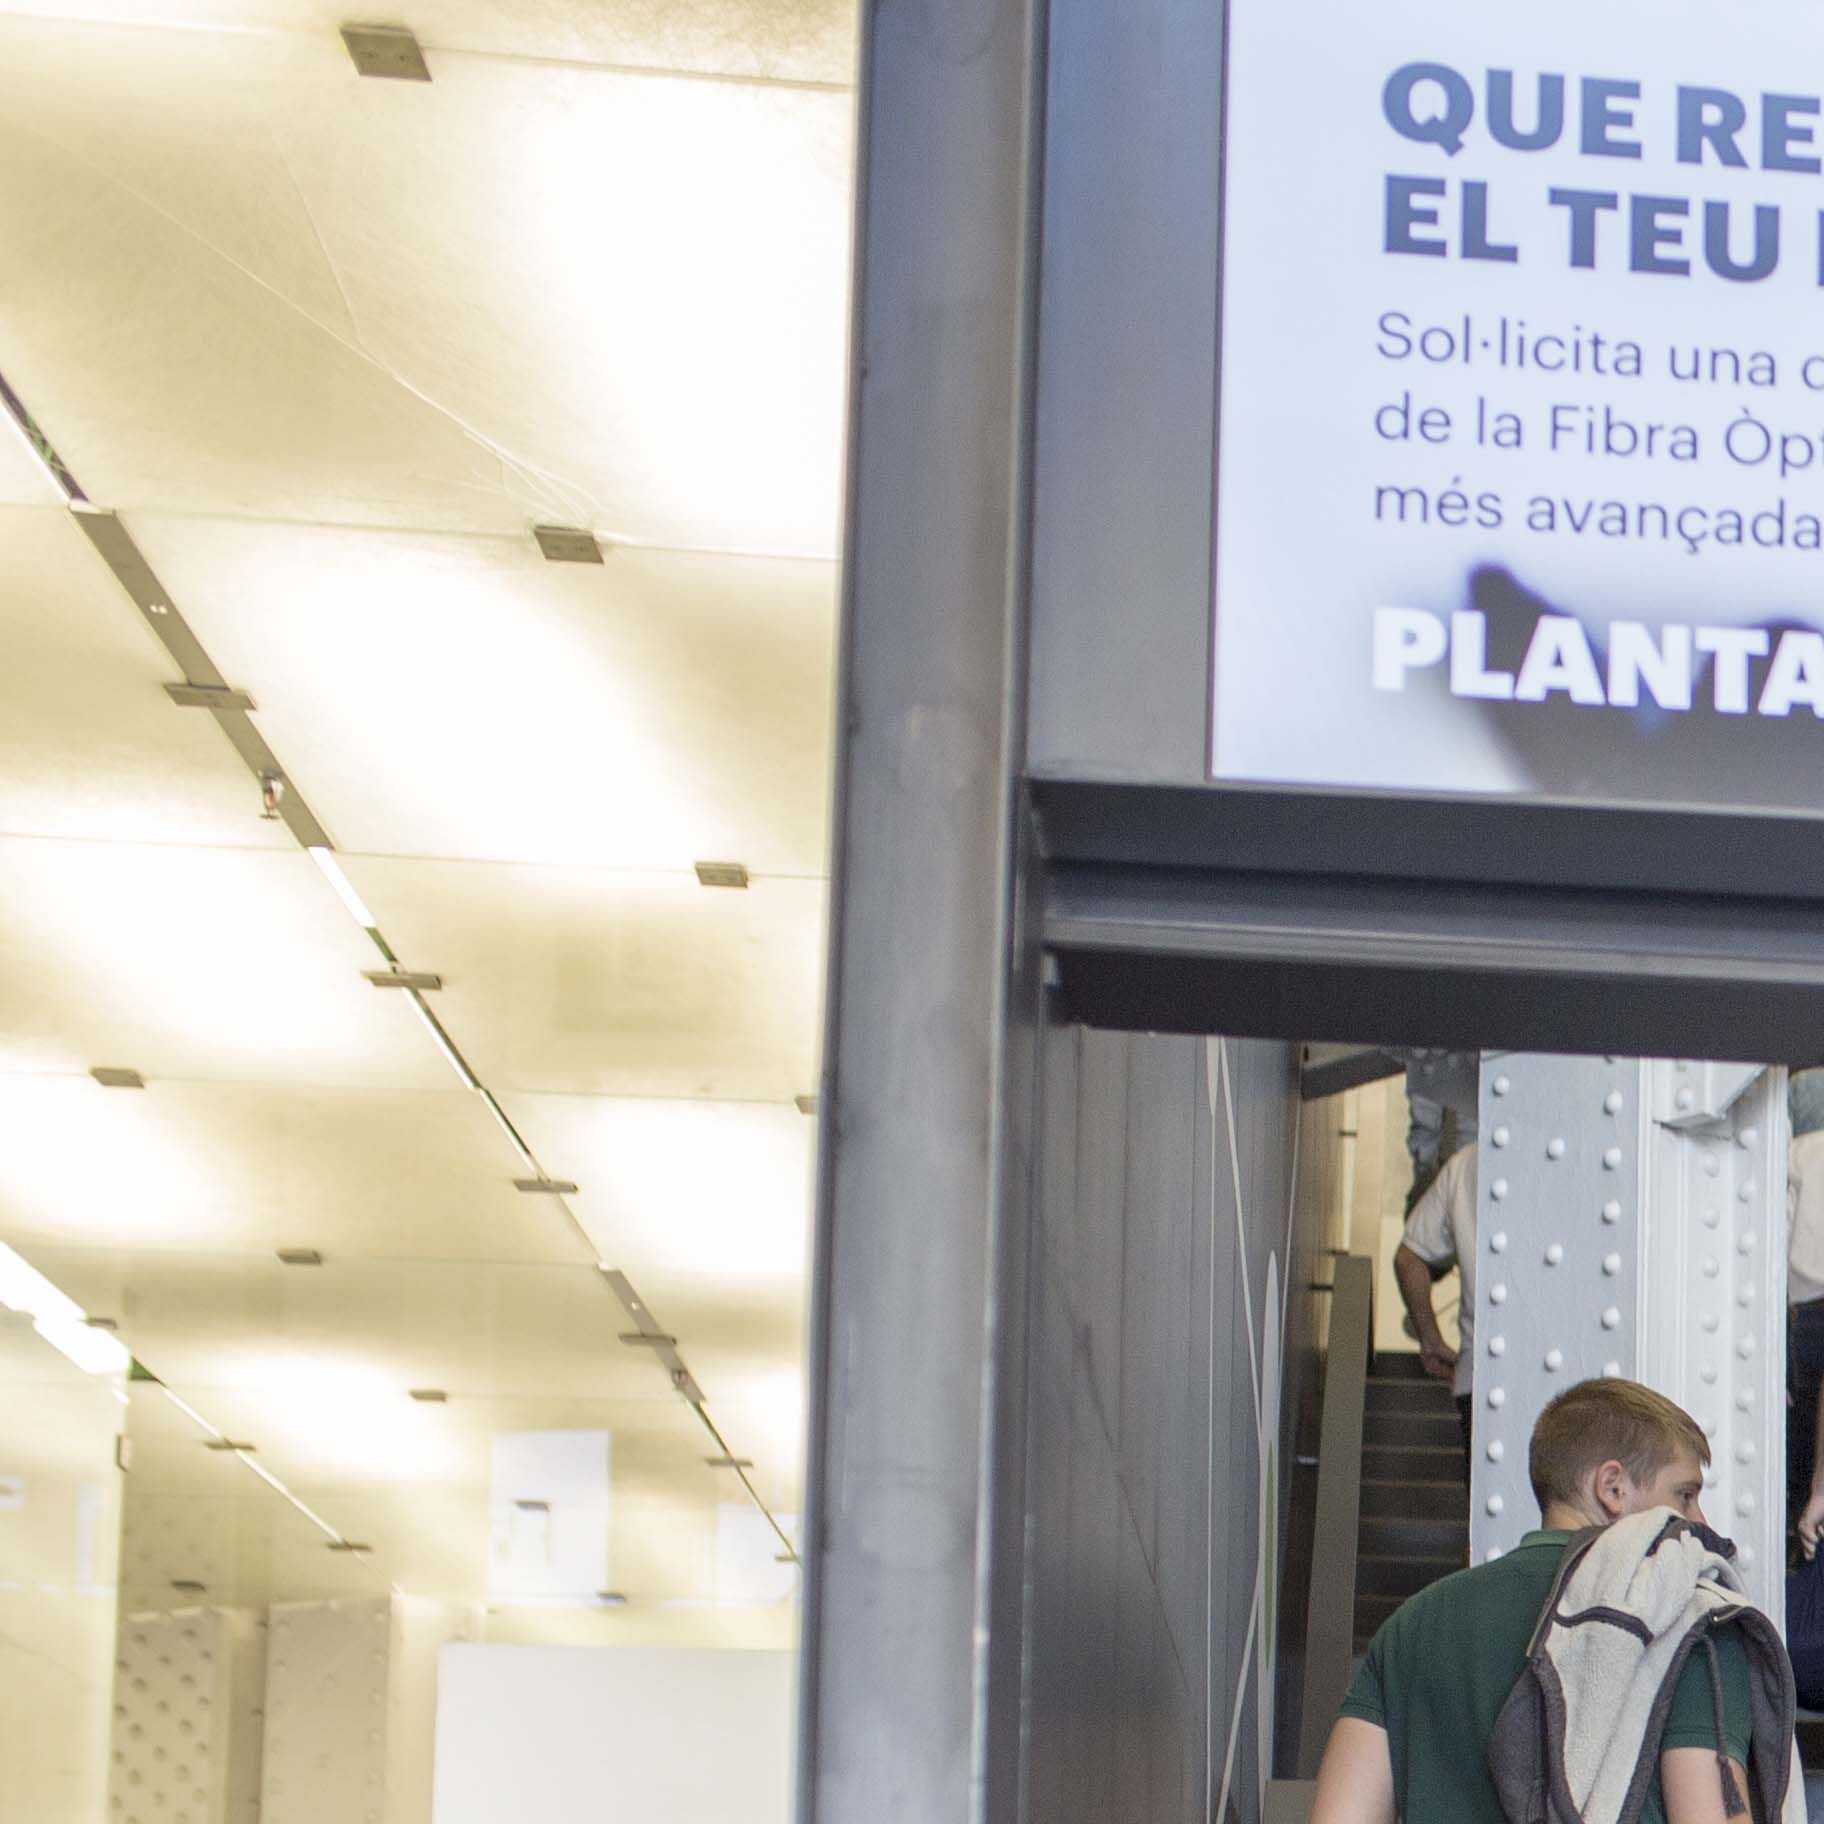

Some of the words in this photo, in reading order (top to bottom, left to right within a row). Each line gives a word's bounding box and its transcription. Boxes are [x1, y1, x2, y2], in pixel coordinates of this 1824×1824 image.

[1382, 62, 1642, 159] QUE
[1384, 174, 1518, 263] EL
[1549, 188, 1779, 283] TEU
[1670, 347, 1775, 386] una
[1375, 392, 1451, 443] de
[1478, 397, 1522, 447] la
[1552, 405, 1698, 460] Fibra
[1376, 478, 1502, 528] més
[1528, 497, 1821, 554] avançada
